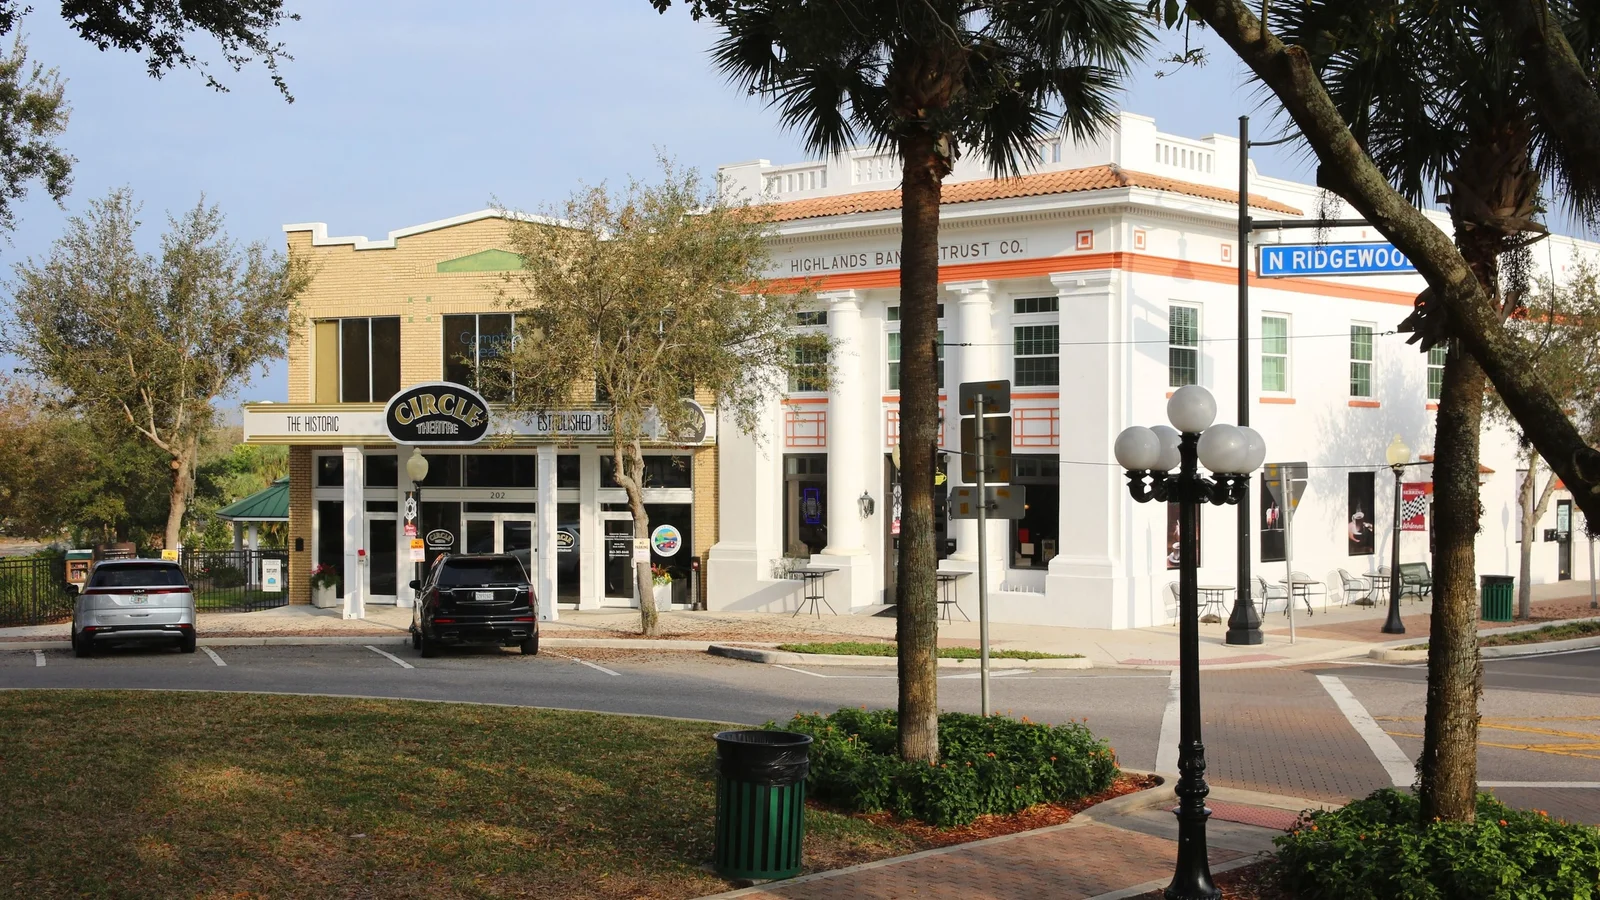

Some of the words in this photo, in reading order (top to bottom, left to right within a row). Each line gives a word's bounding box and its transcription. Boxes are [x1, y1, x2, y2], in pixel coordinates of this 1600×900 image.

[791, 253, 868, 273] HIGHLANDS
[874, 250, 901, 265] BAN
[940, 243, 990, 261] TRUST
[1000, 240, 1024, 255] CO.
[1269, 251, 1283, 270] N
[1292, 248, 1414, 270] RIDGEWOO
[460, 331, 522, 345] Comptn
[394, 393, 484, 428] CIRCLE
[286, 415, 301, 432] THE
[304, 415, 340, 432] HISTORIC
[416, 420, 459, 435] THEATRE
